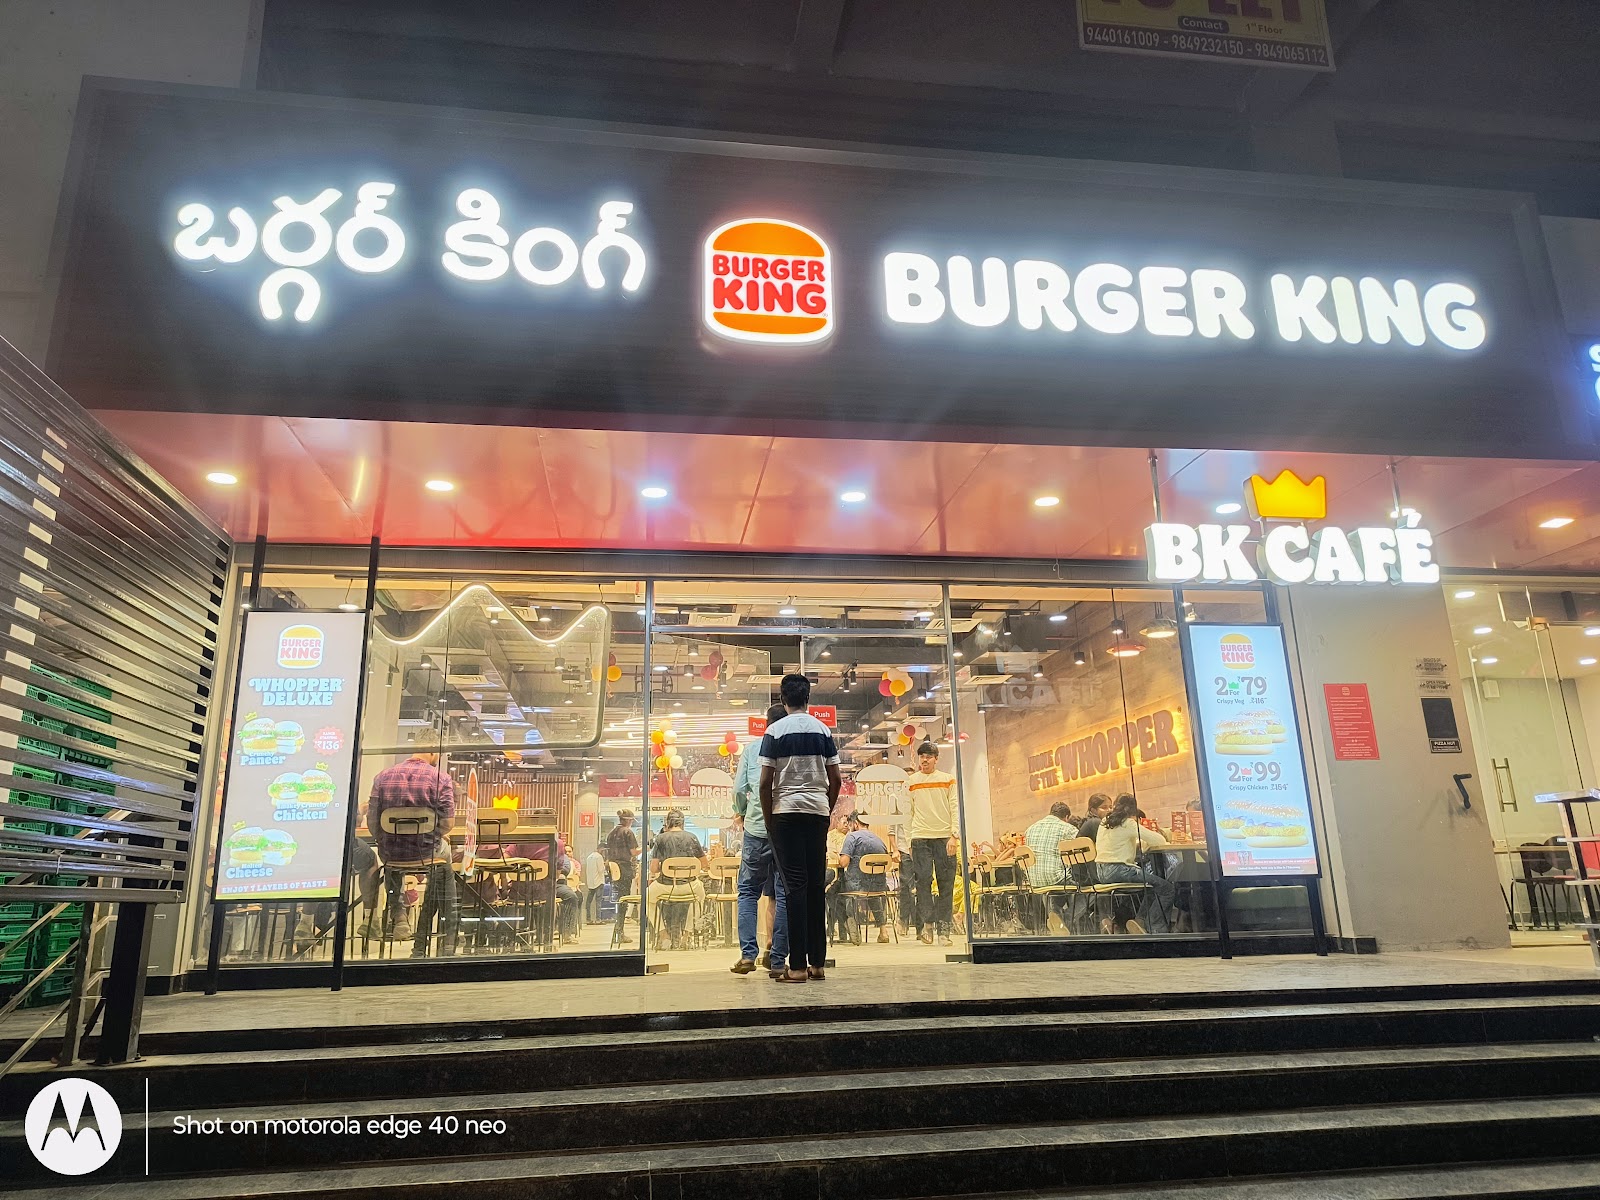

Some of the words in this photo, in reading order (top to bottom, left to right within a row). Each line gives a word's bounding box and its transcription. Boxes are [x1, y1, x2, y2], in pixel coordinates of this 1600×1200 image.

[1182, 18, 1223, 30] Contact
[1258, 24, 1283, 35] Floor
[1086, 26, 1160, 47] 9440161009
[1172, 34, 1243, 56] 9849232150
[1255, 42, 1326, 64] 9849065112
[174, 180, 406, 323] బర్గర్
[441, 187, 647, 292] కింగ్
[712, 253, 825, 282] BURGER
[712, 277, 827, 315] KING
[883, 251, 1255, 341] BURGER
[1270, 273, 1487, 351] KING
[1147, 521, 1258, 584] BK
[1258, 507, 1440, 584] CAFÉ
[281, 638, 322, 648] BURGER
[1220, 644, 1253, 652] BURGER
[280, 647, 321, 659] KING
[1221, 652, 1255, 663] KING
[248, 677, 345, 692] WHOPPER
[1214, 676, 1228, 695] 2
[262, 692, 334, 706] DELUXE
[752, 721, 765, 729] Push
[1055, 710, 1180, 783] WHOPPER
[240, 755, 287, 766] Paneer
[1226, 761, 1241, 782] 2
[856, 782, 910, 796] BURGER
[856, 794, 912, 815] KING
[273, 809, 328, 821] Chicken
[226, 867, 273, 879] Cheese
[222, 886, 249, 894] ENJOY
[250, 884, 256, 892] 7
[257, 883, 288, 892] LAYERS
[289, 881, 300, 889] OF
[302, 880, 327, 888] TASTE
